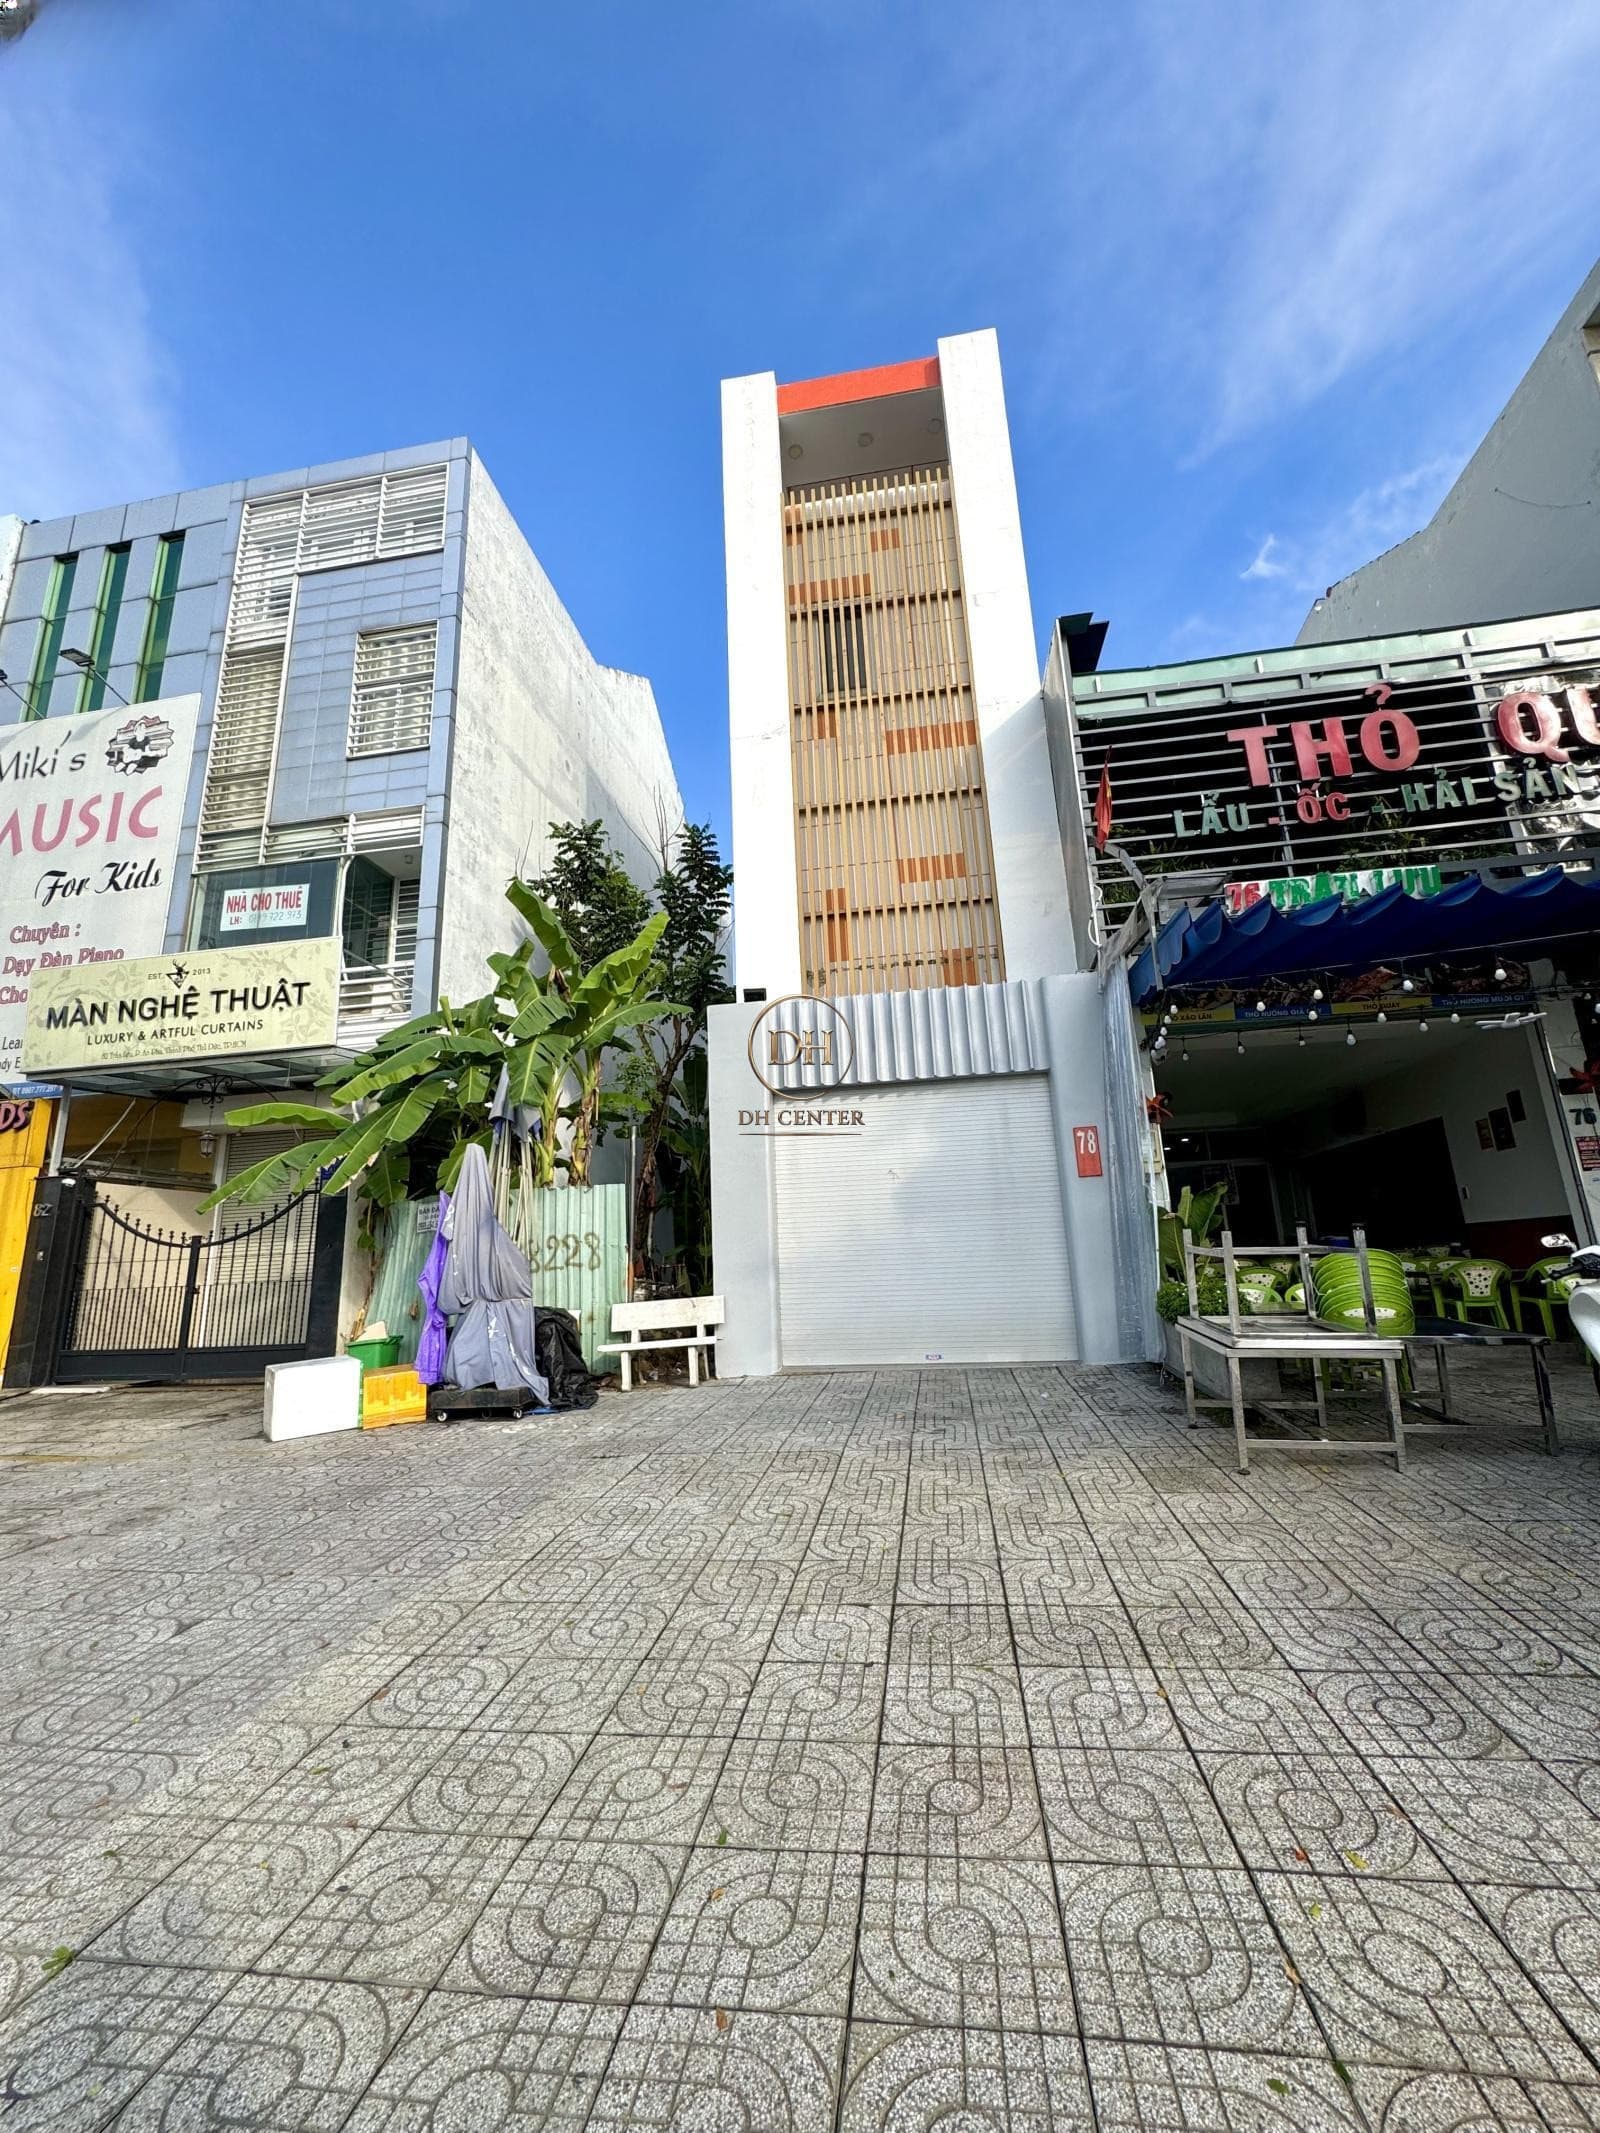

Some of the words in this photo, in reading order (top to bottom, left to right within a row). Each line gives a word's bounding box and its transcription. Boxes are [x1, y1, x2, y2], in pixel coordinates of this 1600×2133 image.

[1226, 684, 1420, 787] THỎ
[1173, 791, 1250, 838] LẨU
[1297, 782, 1350, 824] ỐC
[1401, 768, 1477, 812] HẢI
[1494, 757, 1582, 801] SẢN
[35, 870, 90, 907] For
[95, 858, 163, 893] Kids
[226, 890, 247, 913] NHÀ
[251, 893, 272, 911] CHO
[274, 885, 302, 909] THUÊ
[1226, 883, 1262, 914] 76
[10, 922, 69, 944] Chuyên
[2, 956, 35, 977] Dạy
[40, 950, 72, 968] Đàn
[78, 947, 124, 964] Piano
[192, 968, 211, 976] 2013
[47, 998, 108, 1030] MÀN
[117, 985, 200, 1021] NGHỆ
[210, 978, 310, 1013] THUẬT
[87, 1031, 133, 1046] LUXURY
[138, 1030, 146, 1041] &
[151, 1026, 196, 1040] ARTFUL
[201, 1019, 264, 1036] CURTAINS
[0, 1058, 10, 1073] dy
[1568, 1107, 1597, 1126] 76
[1076, 1130, 1097, 1154] 78
